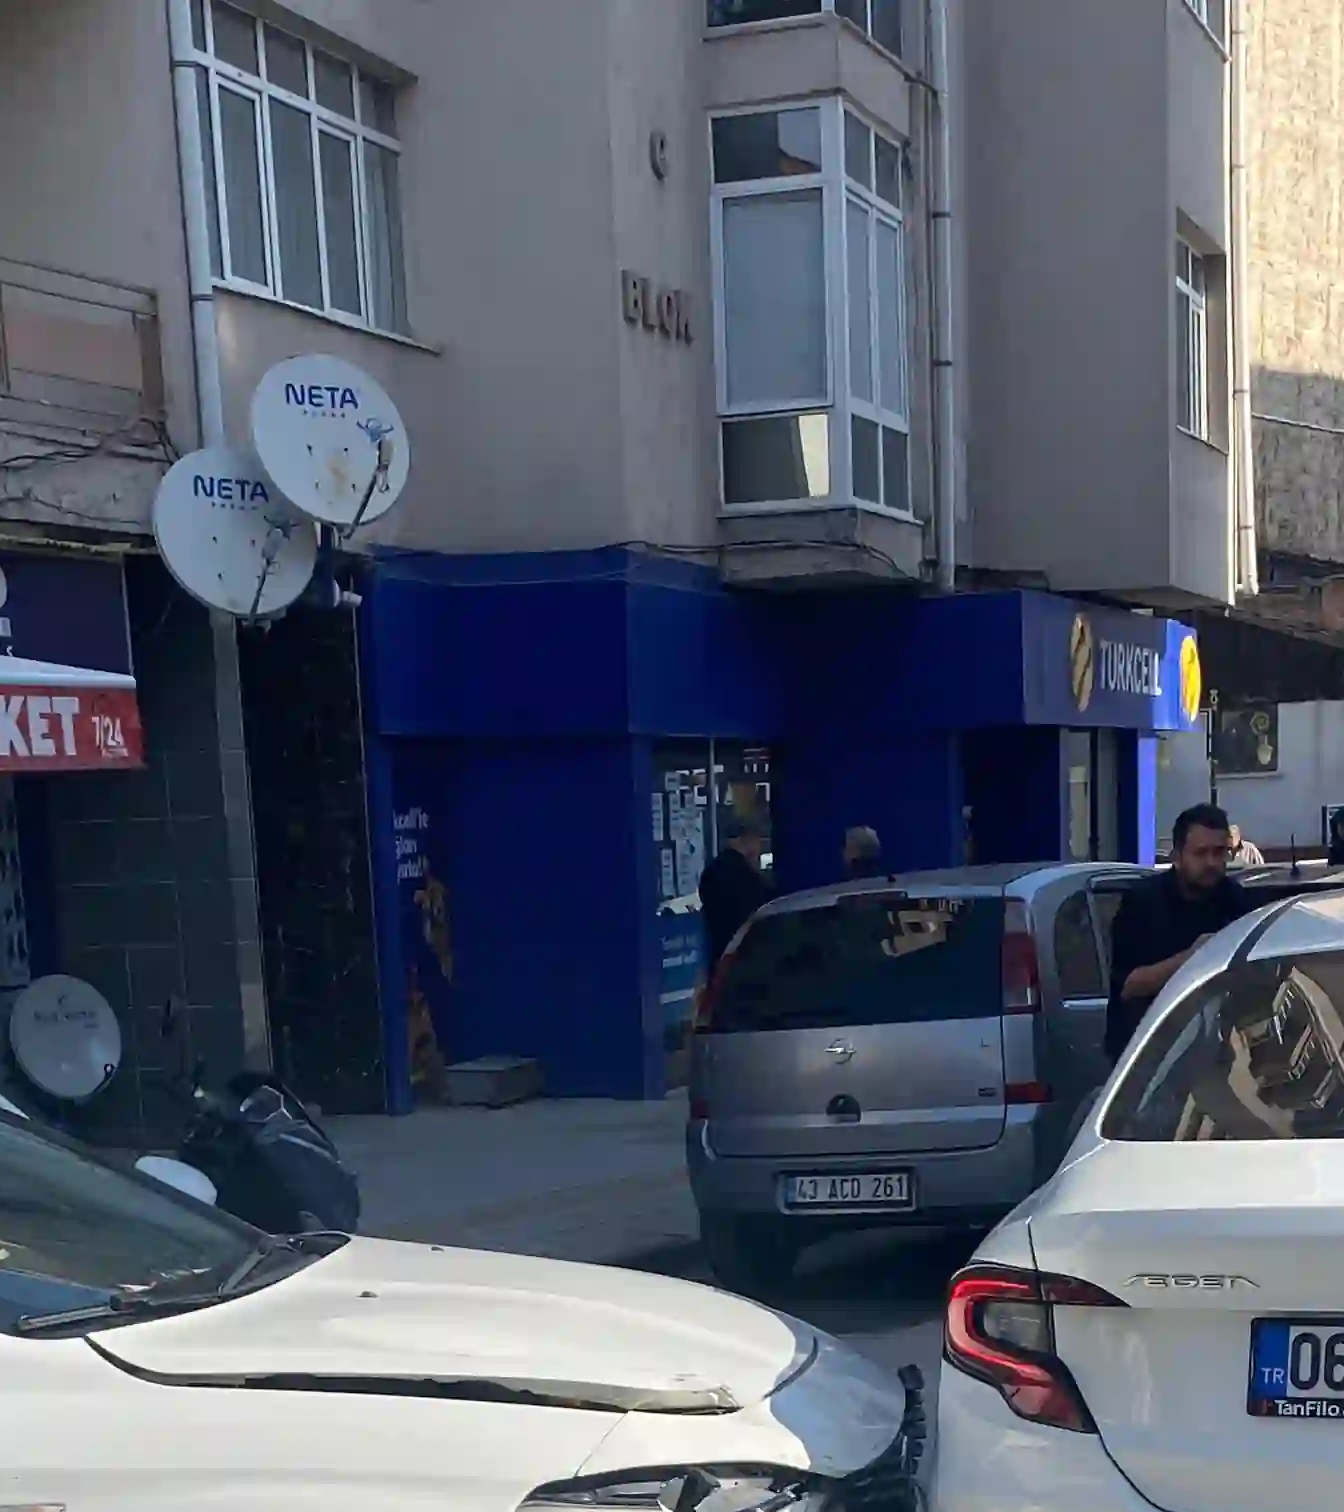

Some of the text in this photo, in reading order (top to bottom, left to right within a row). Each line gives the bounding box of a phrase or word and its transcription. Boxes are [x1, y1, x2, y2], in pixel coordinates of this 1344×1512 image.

[285, 383, 358, 409] NETA
[193, 475, 269, 503] NETA
[1099, 641, 1162, 696] TURKCELL
[872, 1176, 904, 1198] 261
[1261, 1367, 1284, 1384] TR
